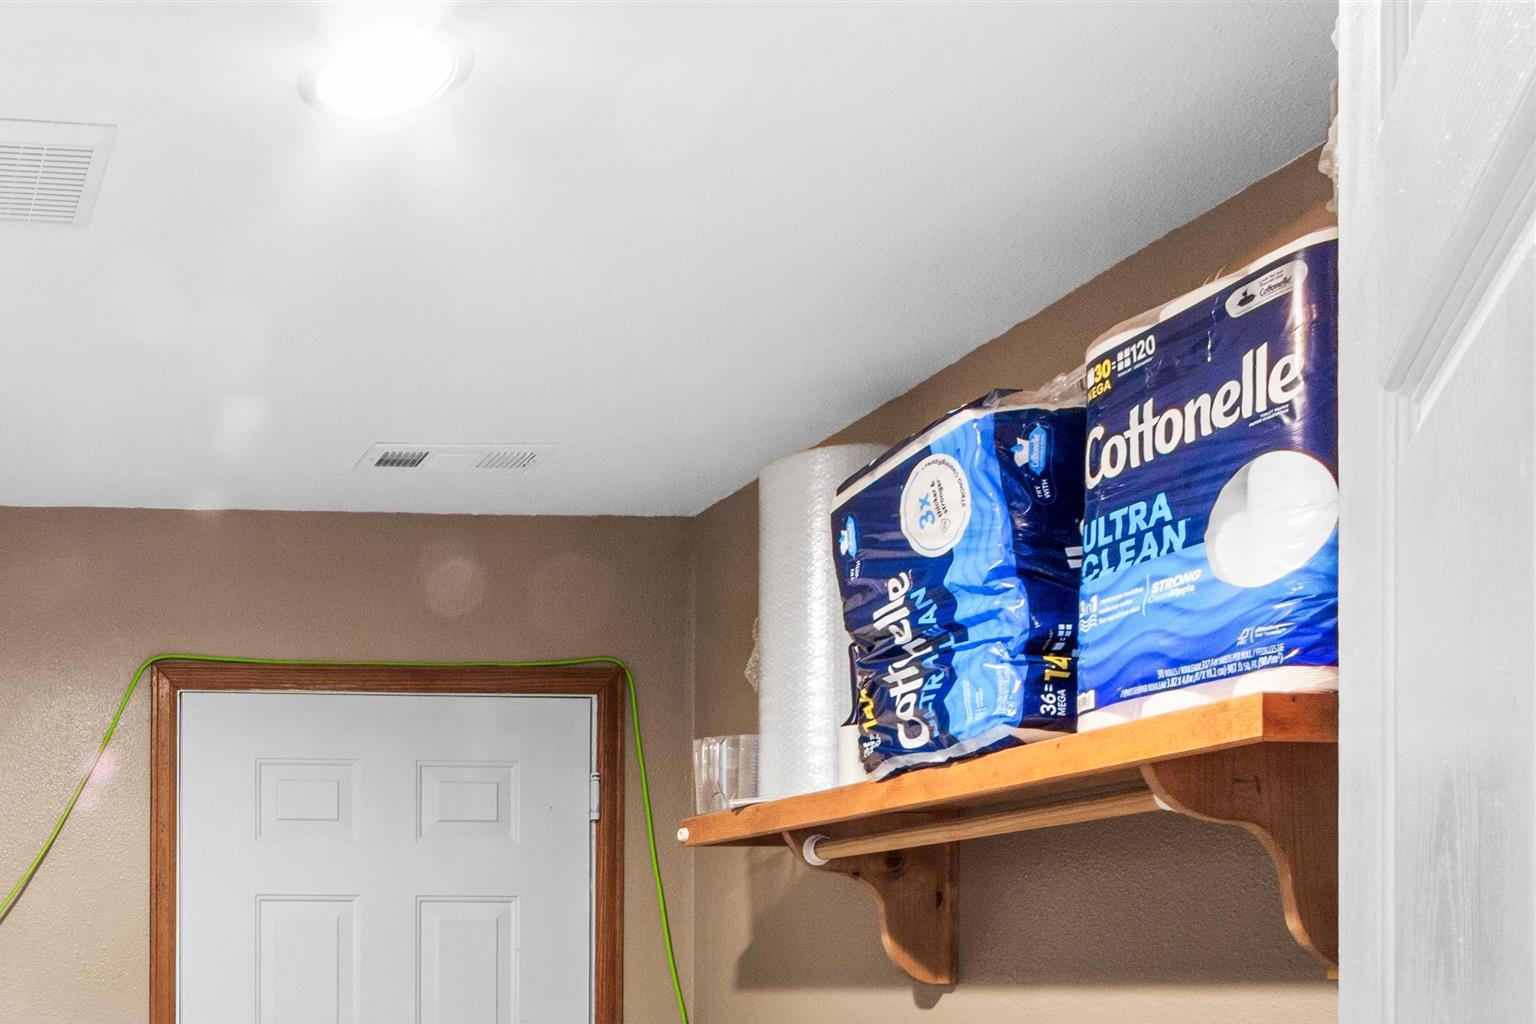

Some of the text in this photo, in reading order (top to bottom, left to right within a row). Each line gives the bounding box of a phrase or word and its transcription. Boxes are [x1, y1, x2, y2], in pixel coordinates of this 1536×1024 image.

[1130, 334, 1156, 363] 120
[1086, 342, 1305, 490] Cottonelle
[1084, 492, 1173, 553] ULTRA
[1082, 518, 1188, 582] CLEAN
[1151, 568, 1203, 594] STRONG
[1057, 688, 1067, 717] MEGA
